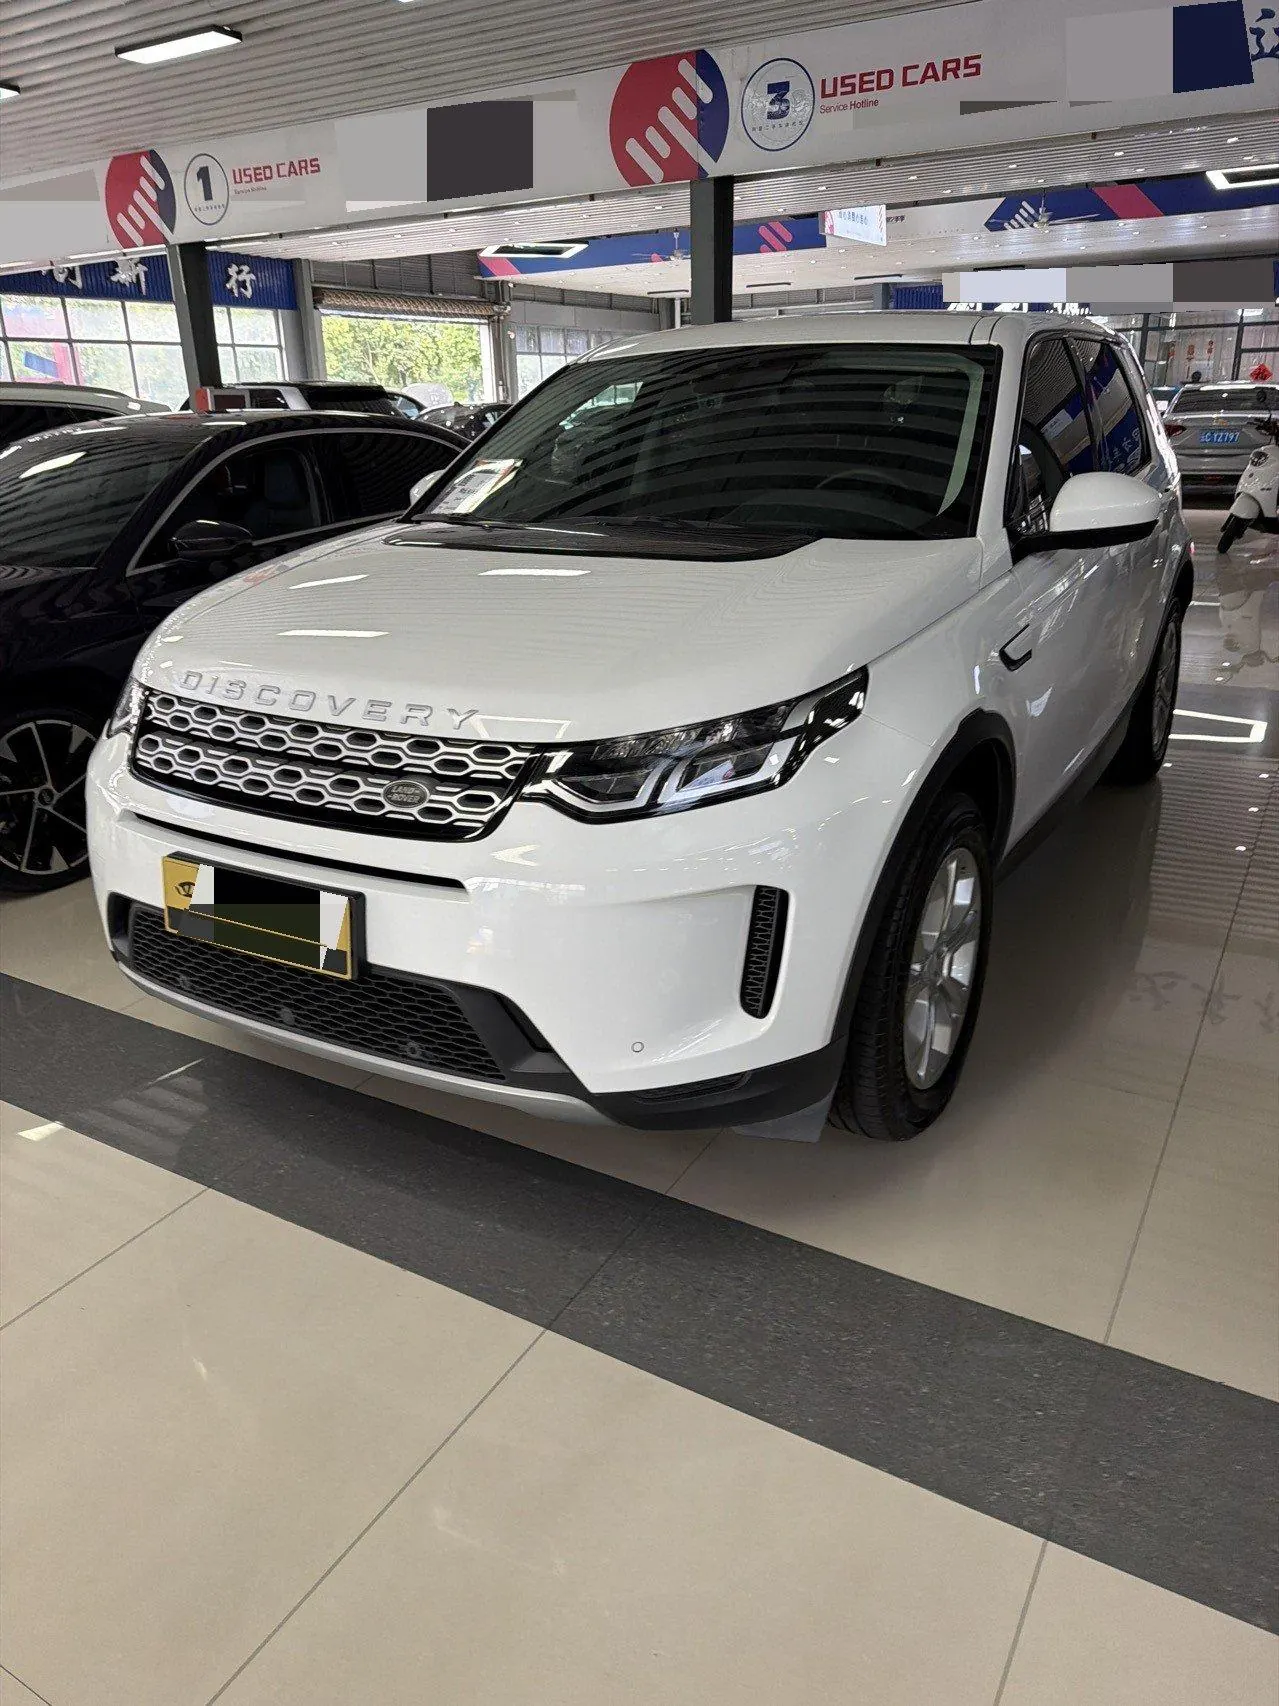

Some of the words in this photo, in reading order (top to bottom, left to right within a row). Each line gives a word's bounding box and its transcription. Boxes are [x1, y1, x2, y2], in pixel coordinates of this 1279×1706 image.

[819, 68, 894, 99] USED
[901, 54, 982, 87] CARS
[766, 81, 790, 120] 3
[819, 101, 849, 115] Service
[849, 97, 880, 111] Hotline
[196, 165, 213, 202] 1
[231, 164, 274, 185] USED
[276, 157, 321, 178] CARS
[178, 669, 480, 730] DISCOVERY
